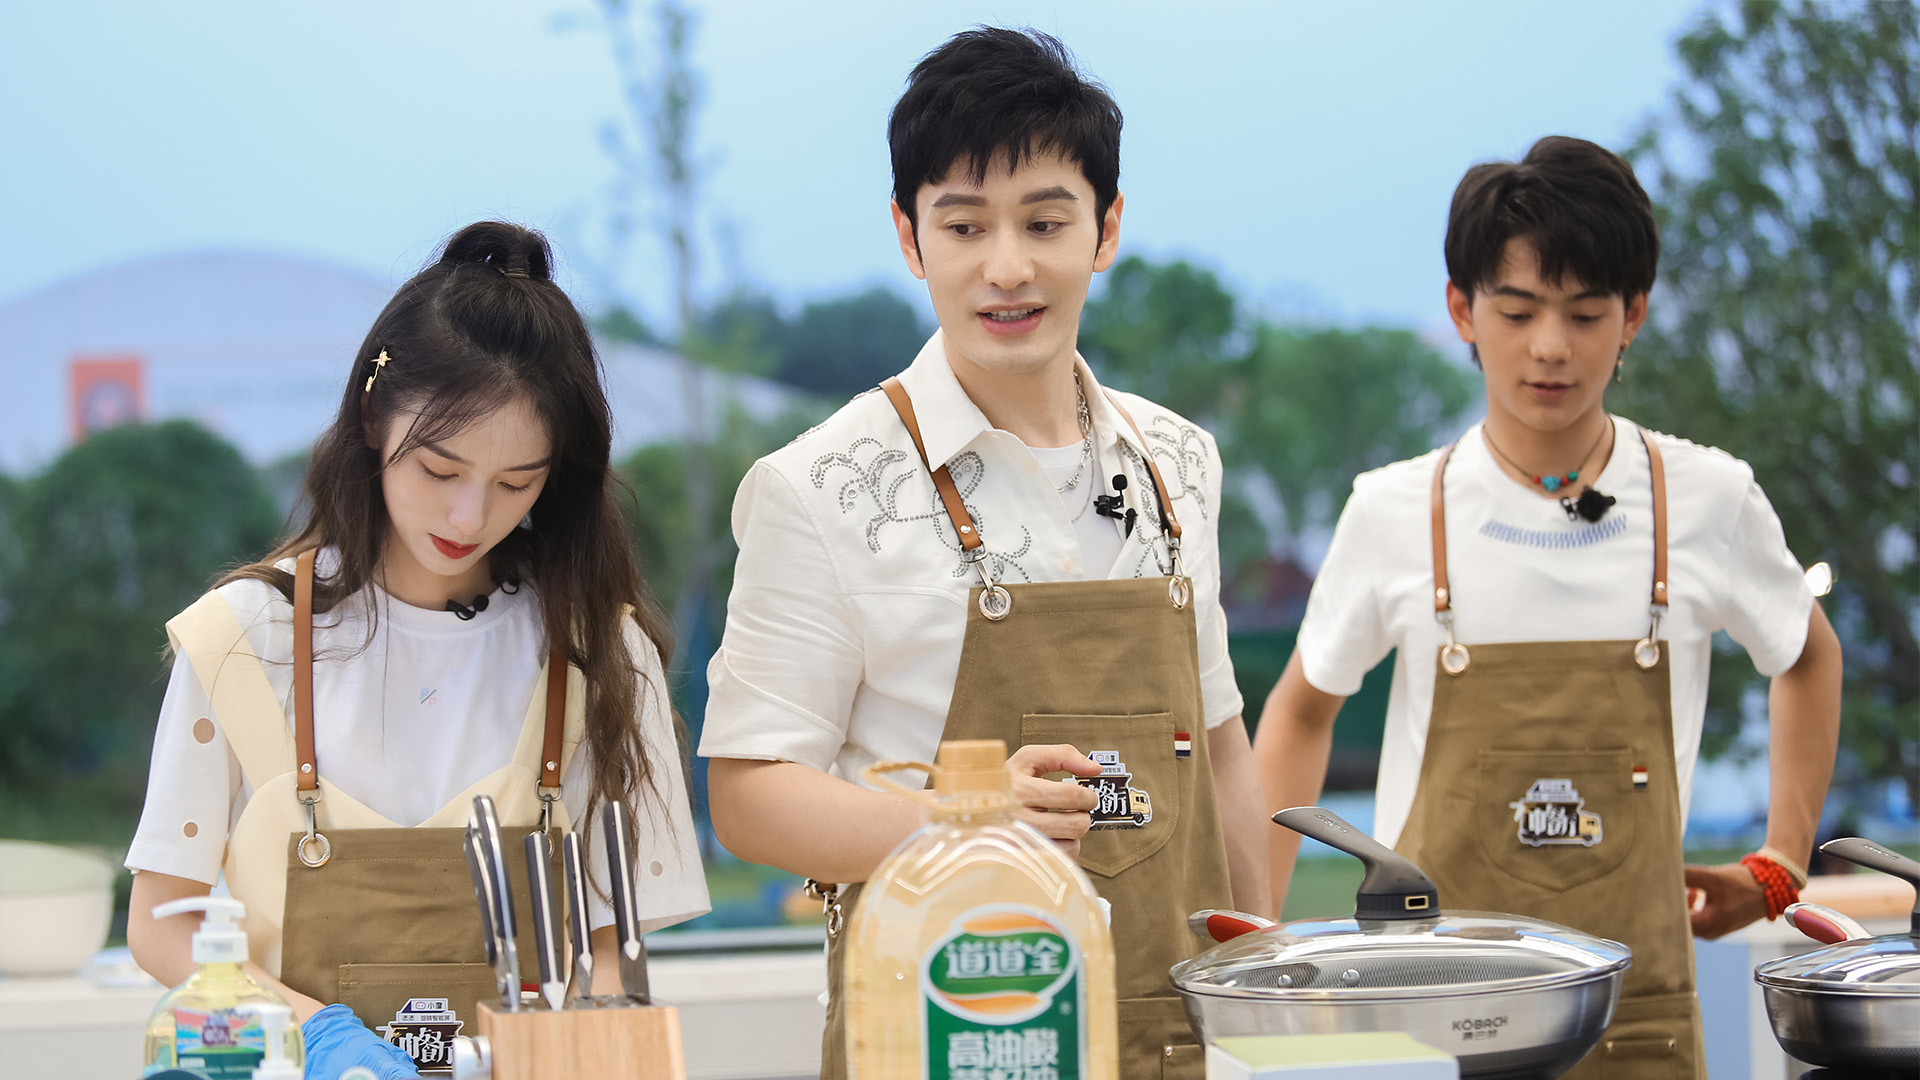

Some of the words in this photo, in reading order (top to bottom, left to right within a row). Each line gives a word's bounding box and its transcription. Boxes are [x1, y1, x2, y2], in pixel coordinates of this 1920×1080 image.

[945, 938, 1063, 978] 道道全
[948, 1028, 1059, 1069] 高油酸
